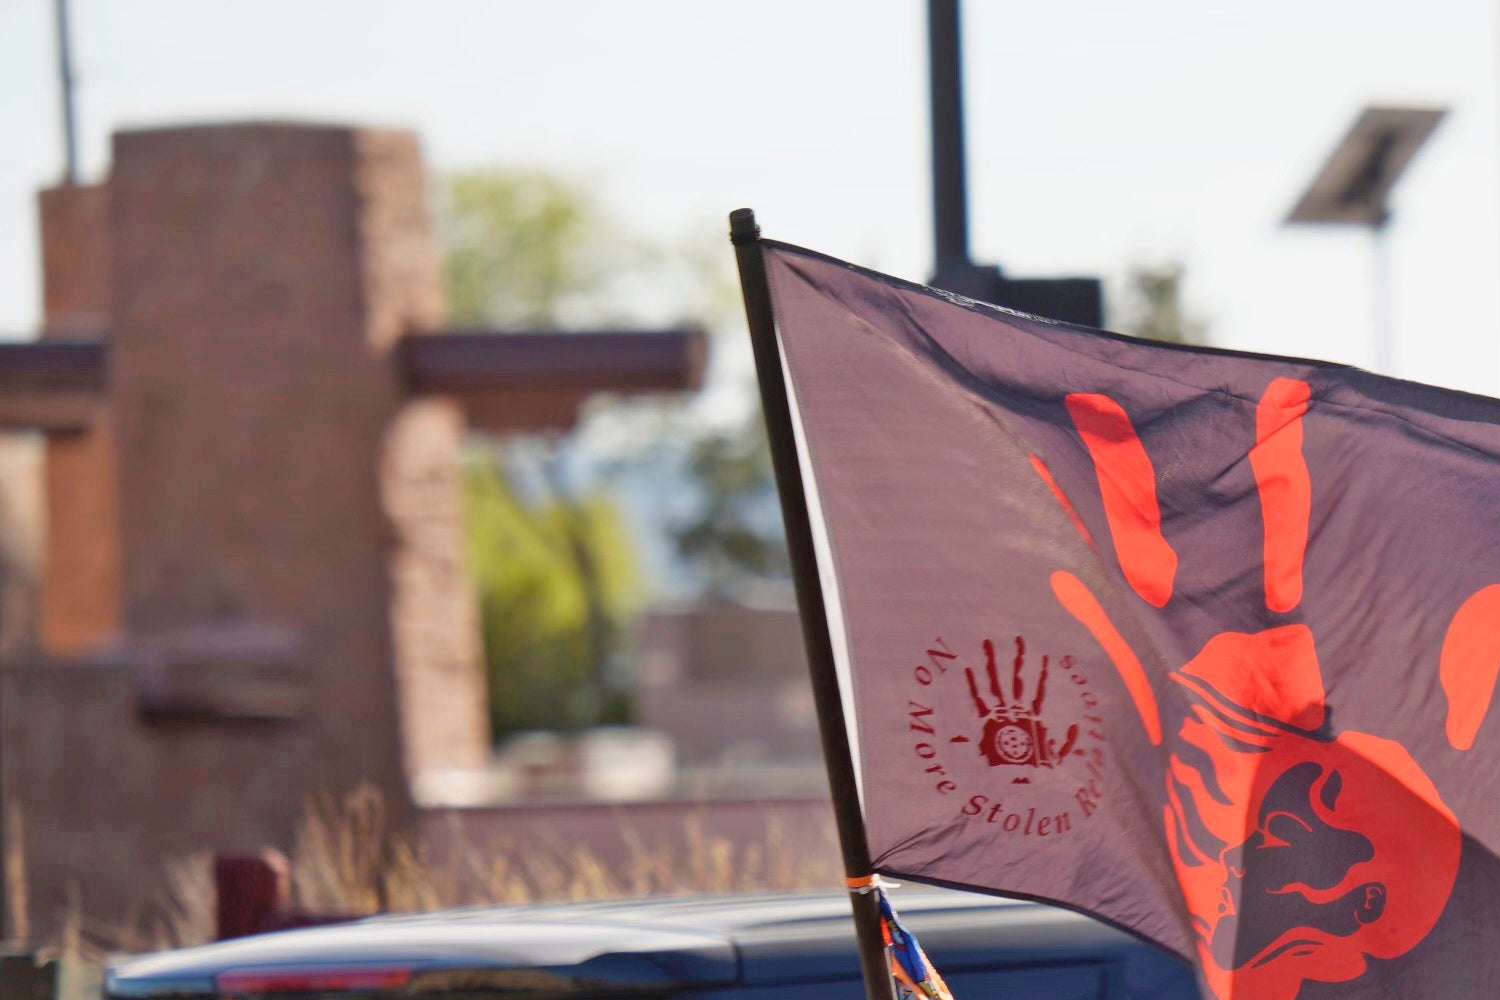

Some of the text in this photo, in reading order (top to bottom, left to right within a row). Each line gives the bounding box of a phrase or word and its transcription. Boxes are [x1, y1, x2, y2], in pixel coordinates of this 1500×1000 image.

[913, 636, 959, 686] No
[908, 698, 958, 796] More
[961, 794, 1073, 837] Stolen
